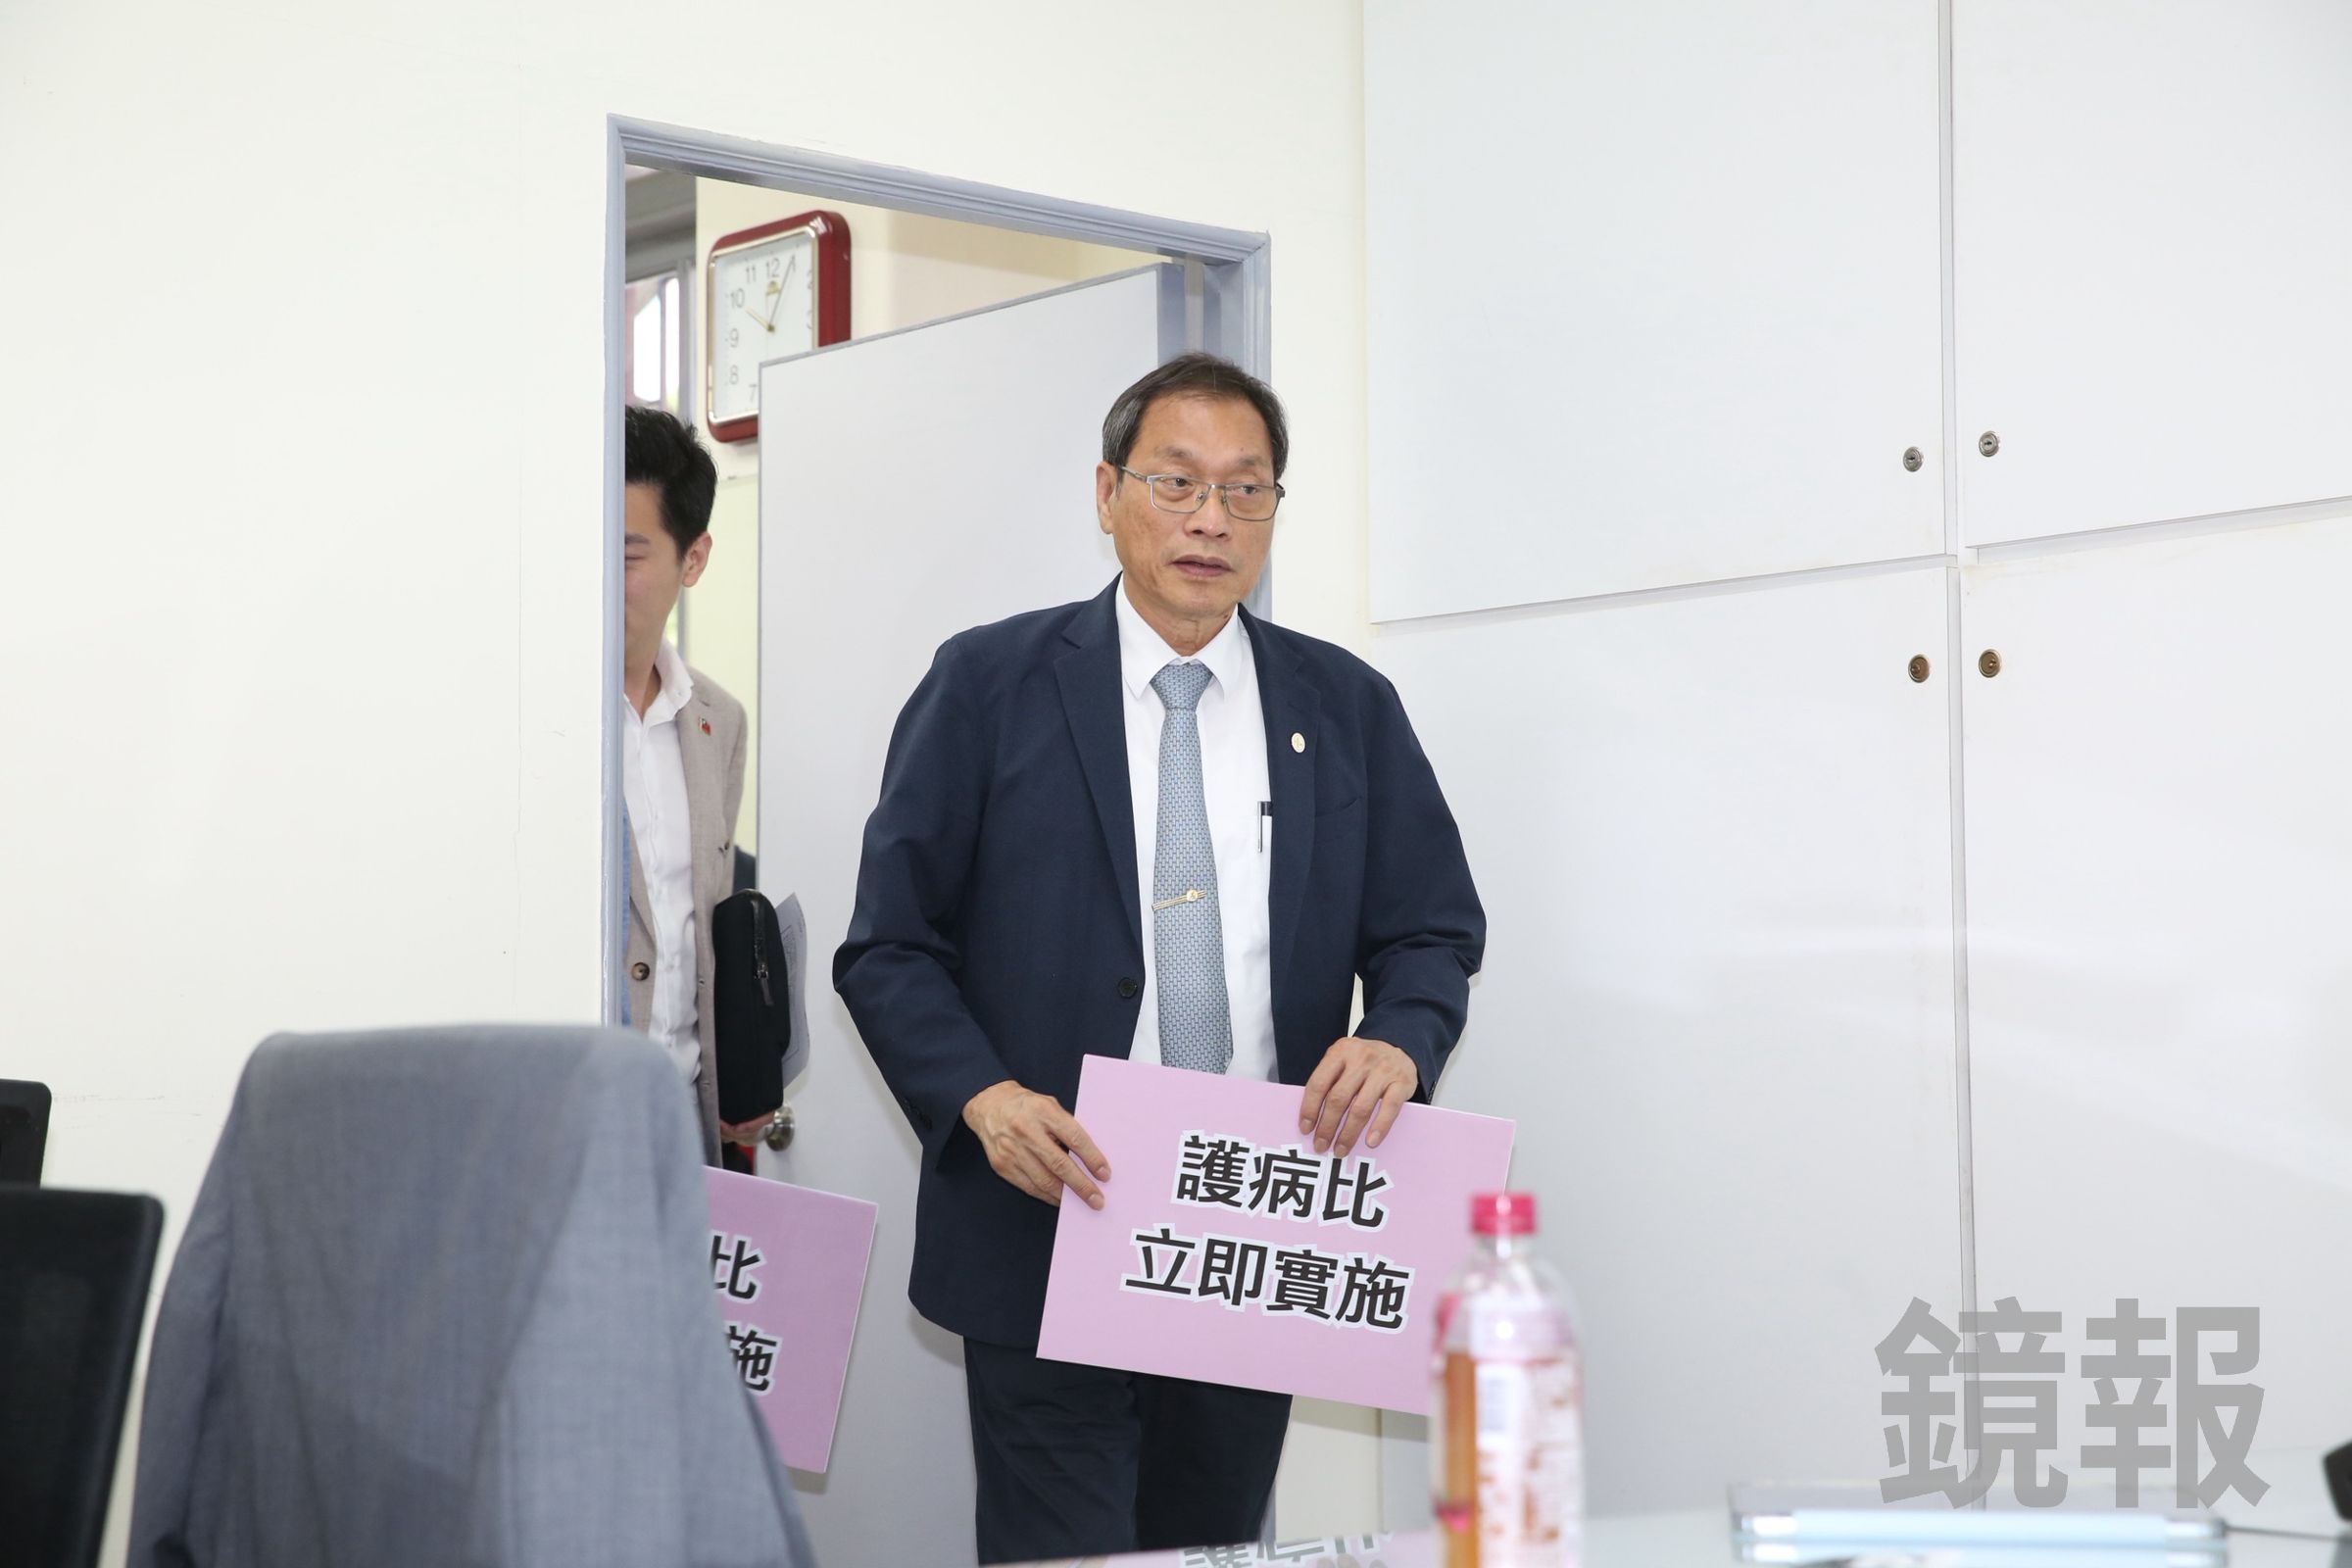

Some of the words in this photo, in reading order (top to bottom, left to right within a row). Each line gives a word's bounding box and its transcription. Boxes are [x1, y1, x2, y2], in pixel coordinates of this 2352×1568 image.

[746, 264, 757, 284] 11
[766, 257, 780, 279] 12
[730, 287, 745, 309] 10
[729, 327, 740, 348] 9
[729, 365, 739, 385] 8
[749, 383, 758, 404] 7
[1176, 1134, 1388, 1228] 護病比
[711, 1235, 760, 1299] 比
[1124, 1228, 1410, 1330] 立即實施
